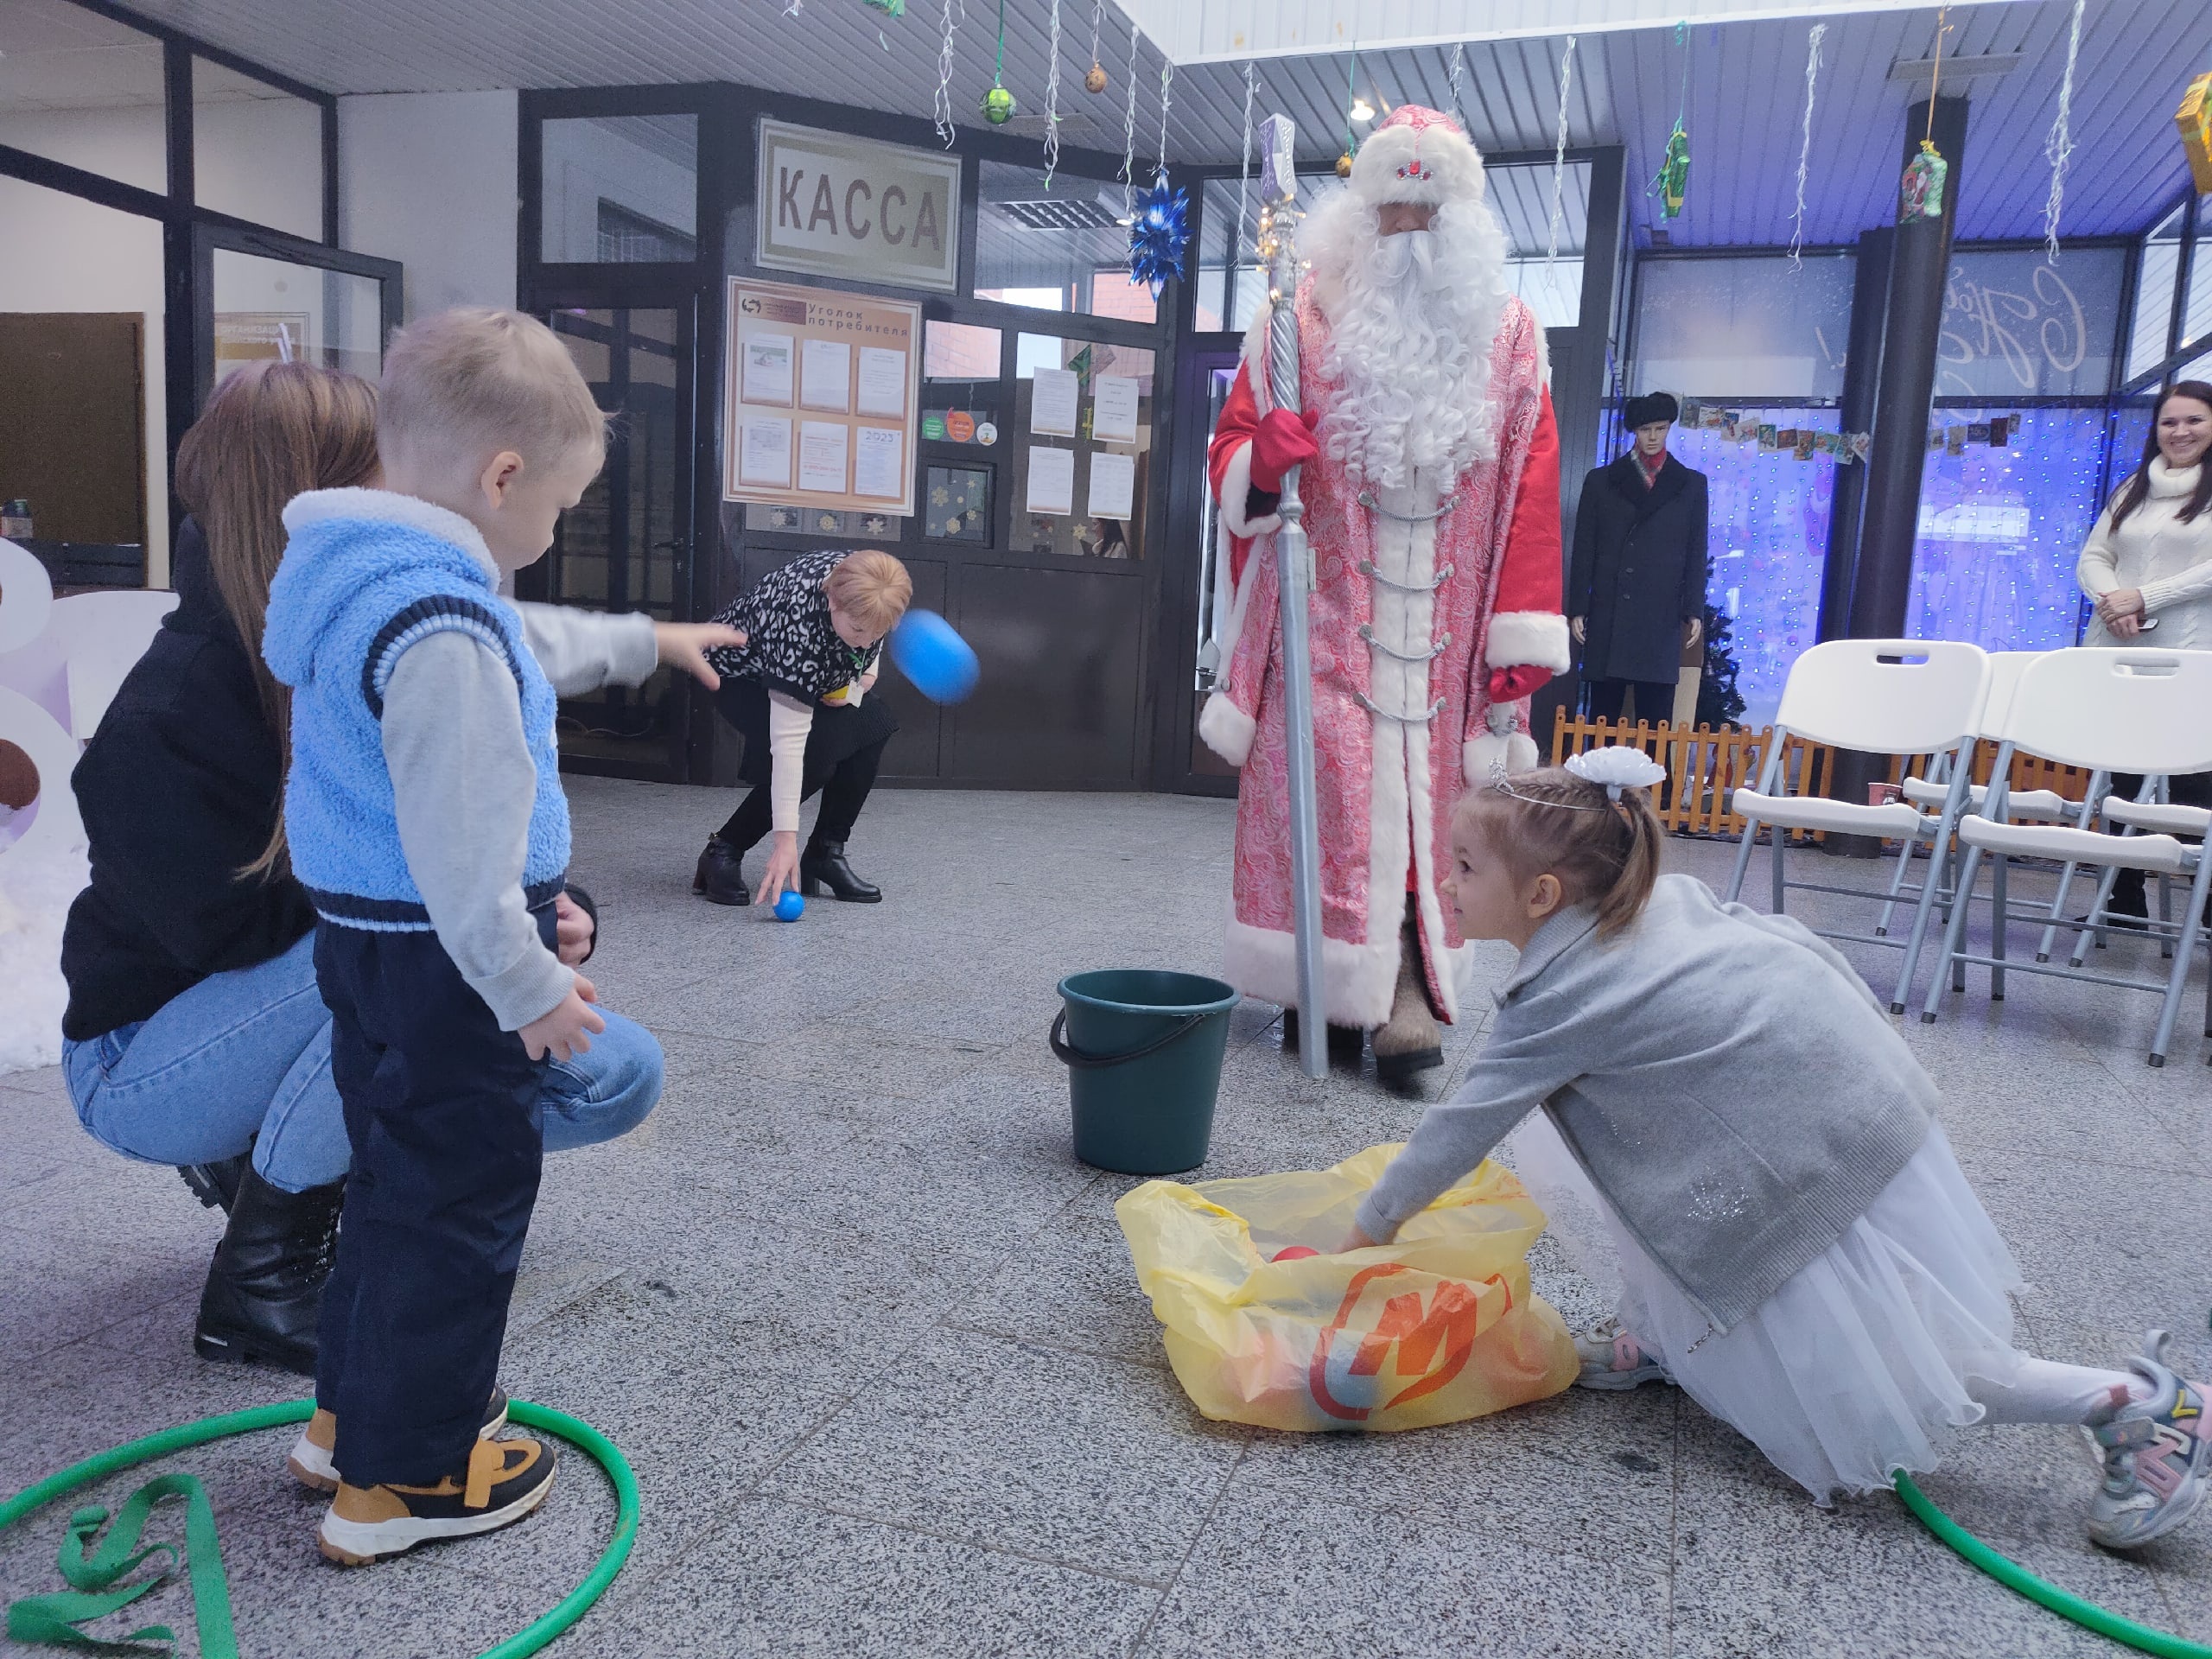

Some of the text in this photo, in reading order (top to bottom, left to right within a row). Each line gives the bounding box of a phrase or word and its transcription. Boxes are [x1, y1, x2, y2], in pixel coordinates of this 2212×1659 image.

[779, 166, 940, 251] КАССА
[808, 303, 863, 320] Уголок
[808, 316, 908, 337] потребителя
[865, 429, 893, 443] 2023
